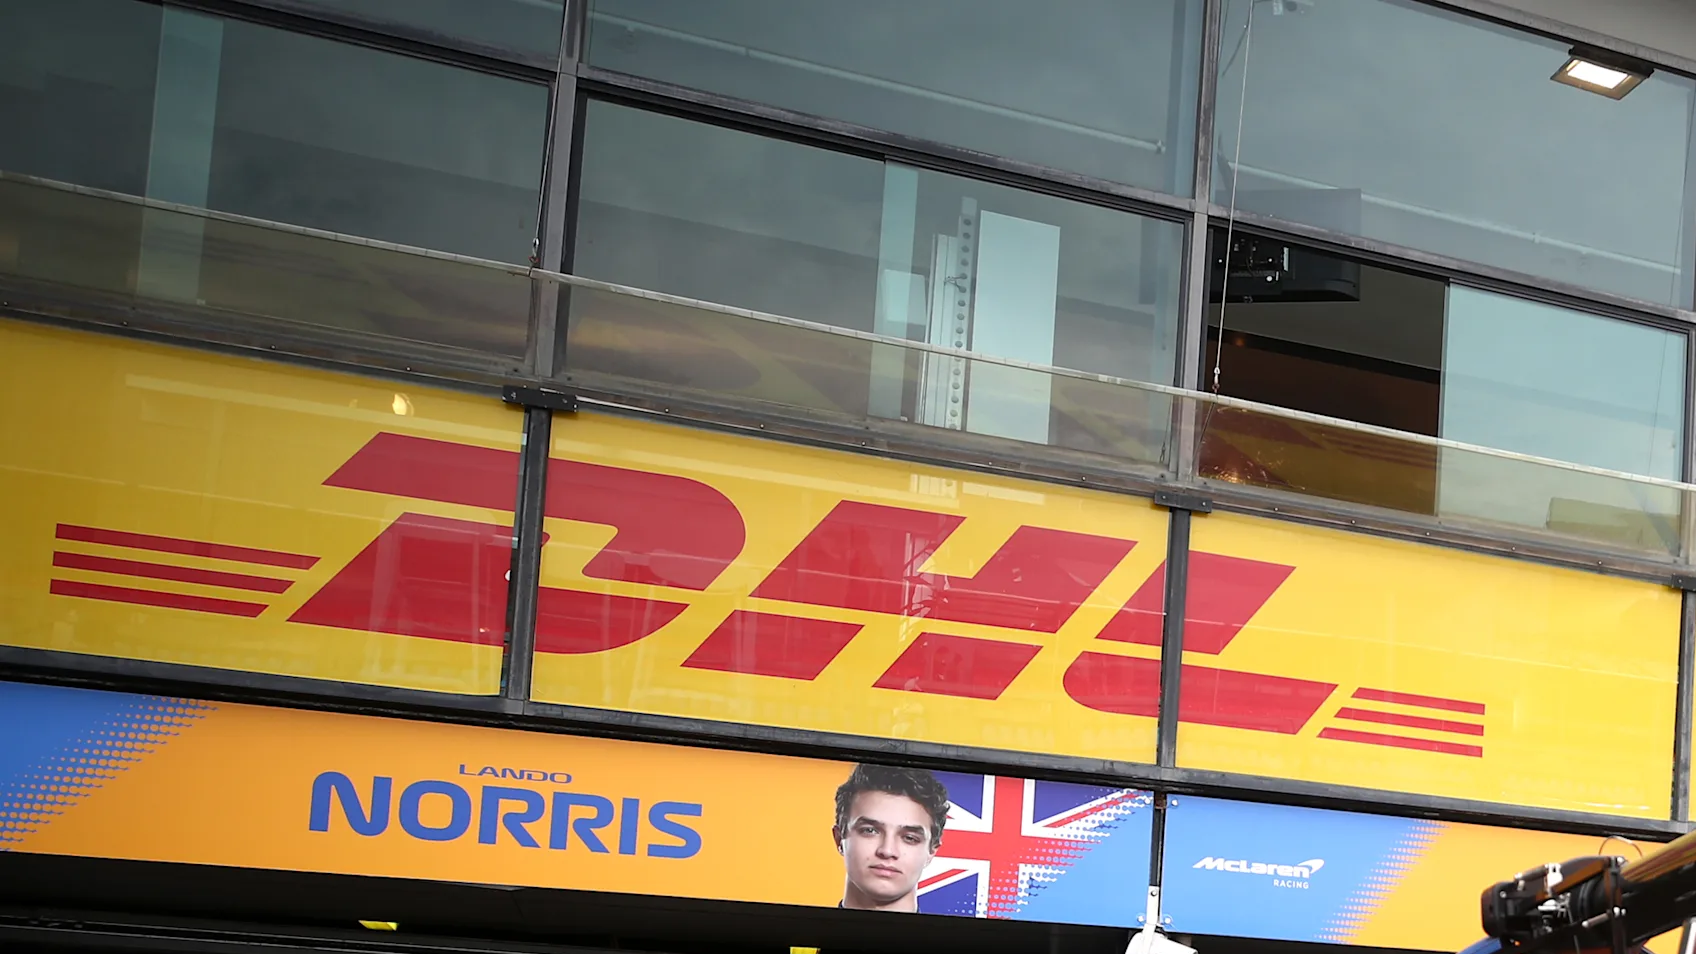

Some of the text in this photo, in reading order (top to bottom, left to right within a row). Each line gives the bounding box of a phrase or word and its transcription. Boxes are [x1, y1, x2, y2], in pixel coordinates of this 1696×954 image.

[285, 432, 1337, 736] DHL
[459, 764, 573, 784] LANDO
[308, 771, 703, 859] NORRIS
[1193, 857, 1313, 879] McLaren
[1273, 878, 1309, 890] RACING
